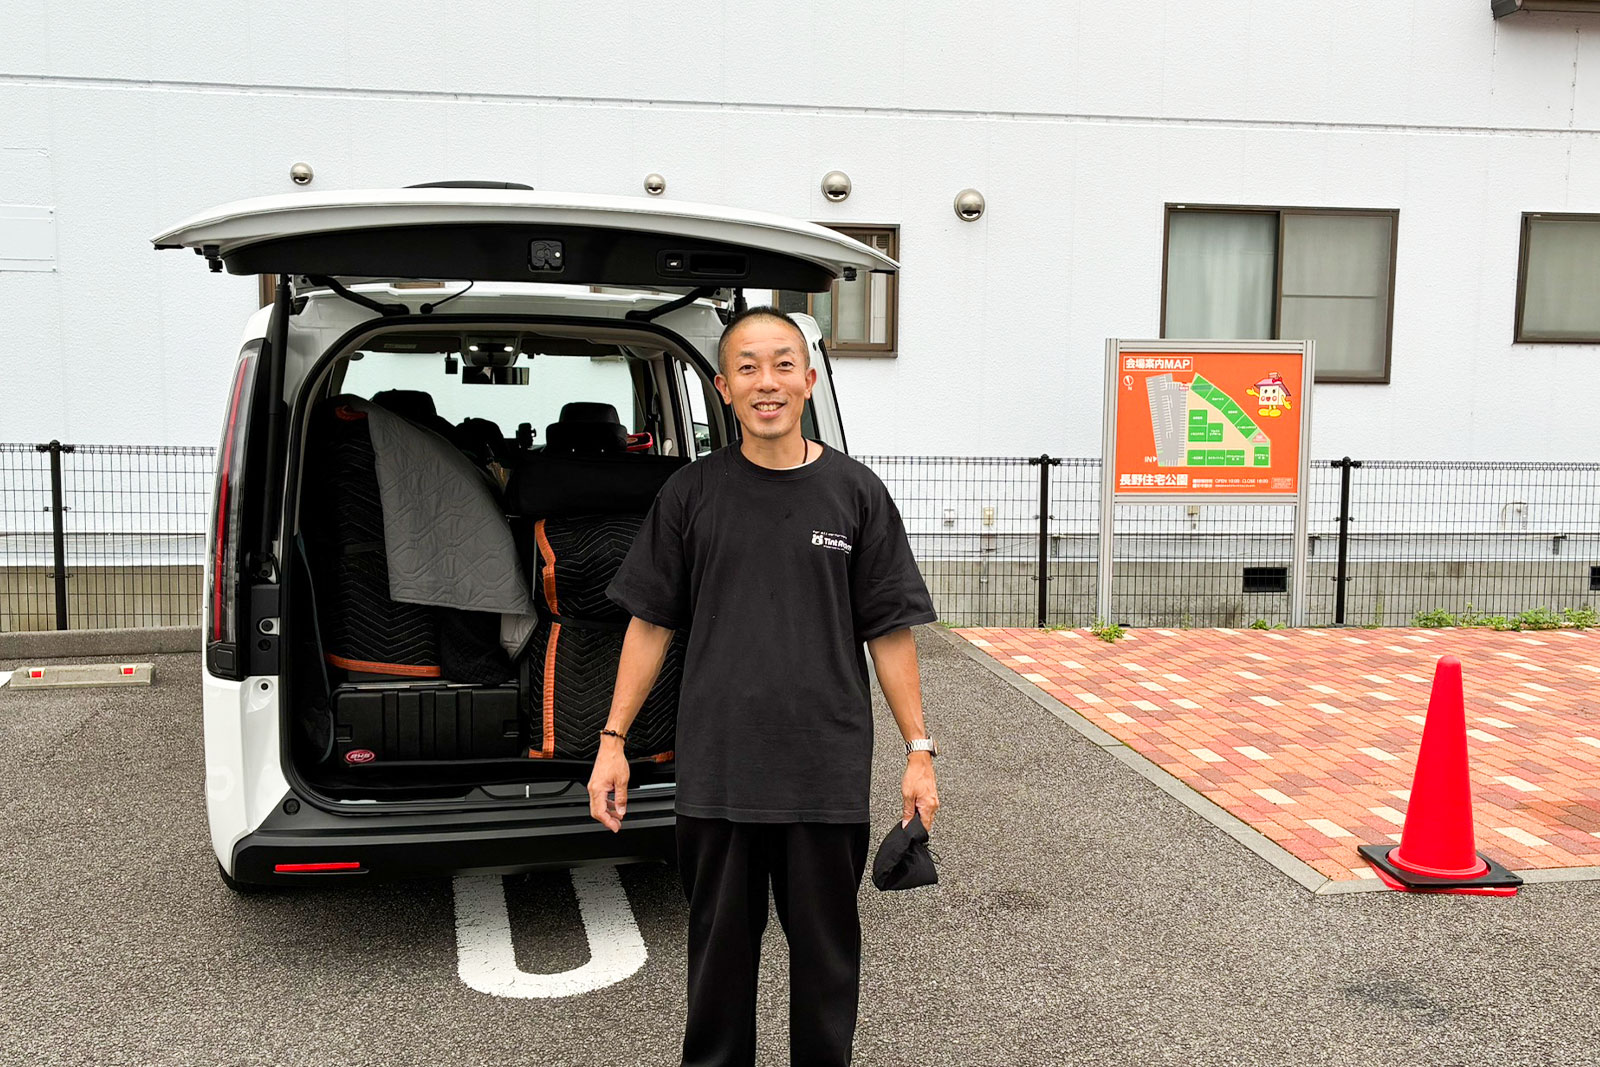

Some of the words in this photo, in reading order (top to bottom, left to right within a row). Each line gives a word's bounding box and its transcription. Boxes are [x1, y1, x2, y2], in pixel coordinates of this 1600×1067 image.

[1120, 473, 1188, 485] 長野住宅公園
